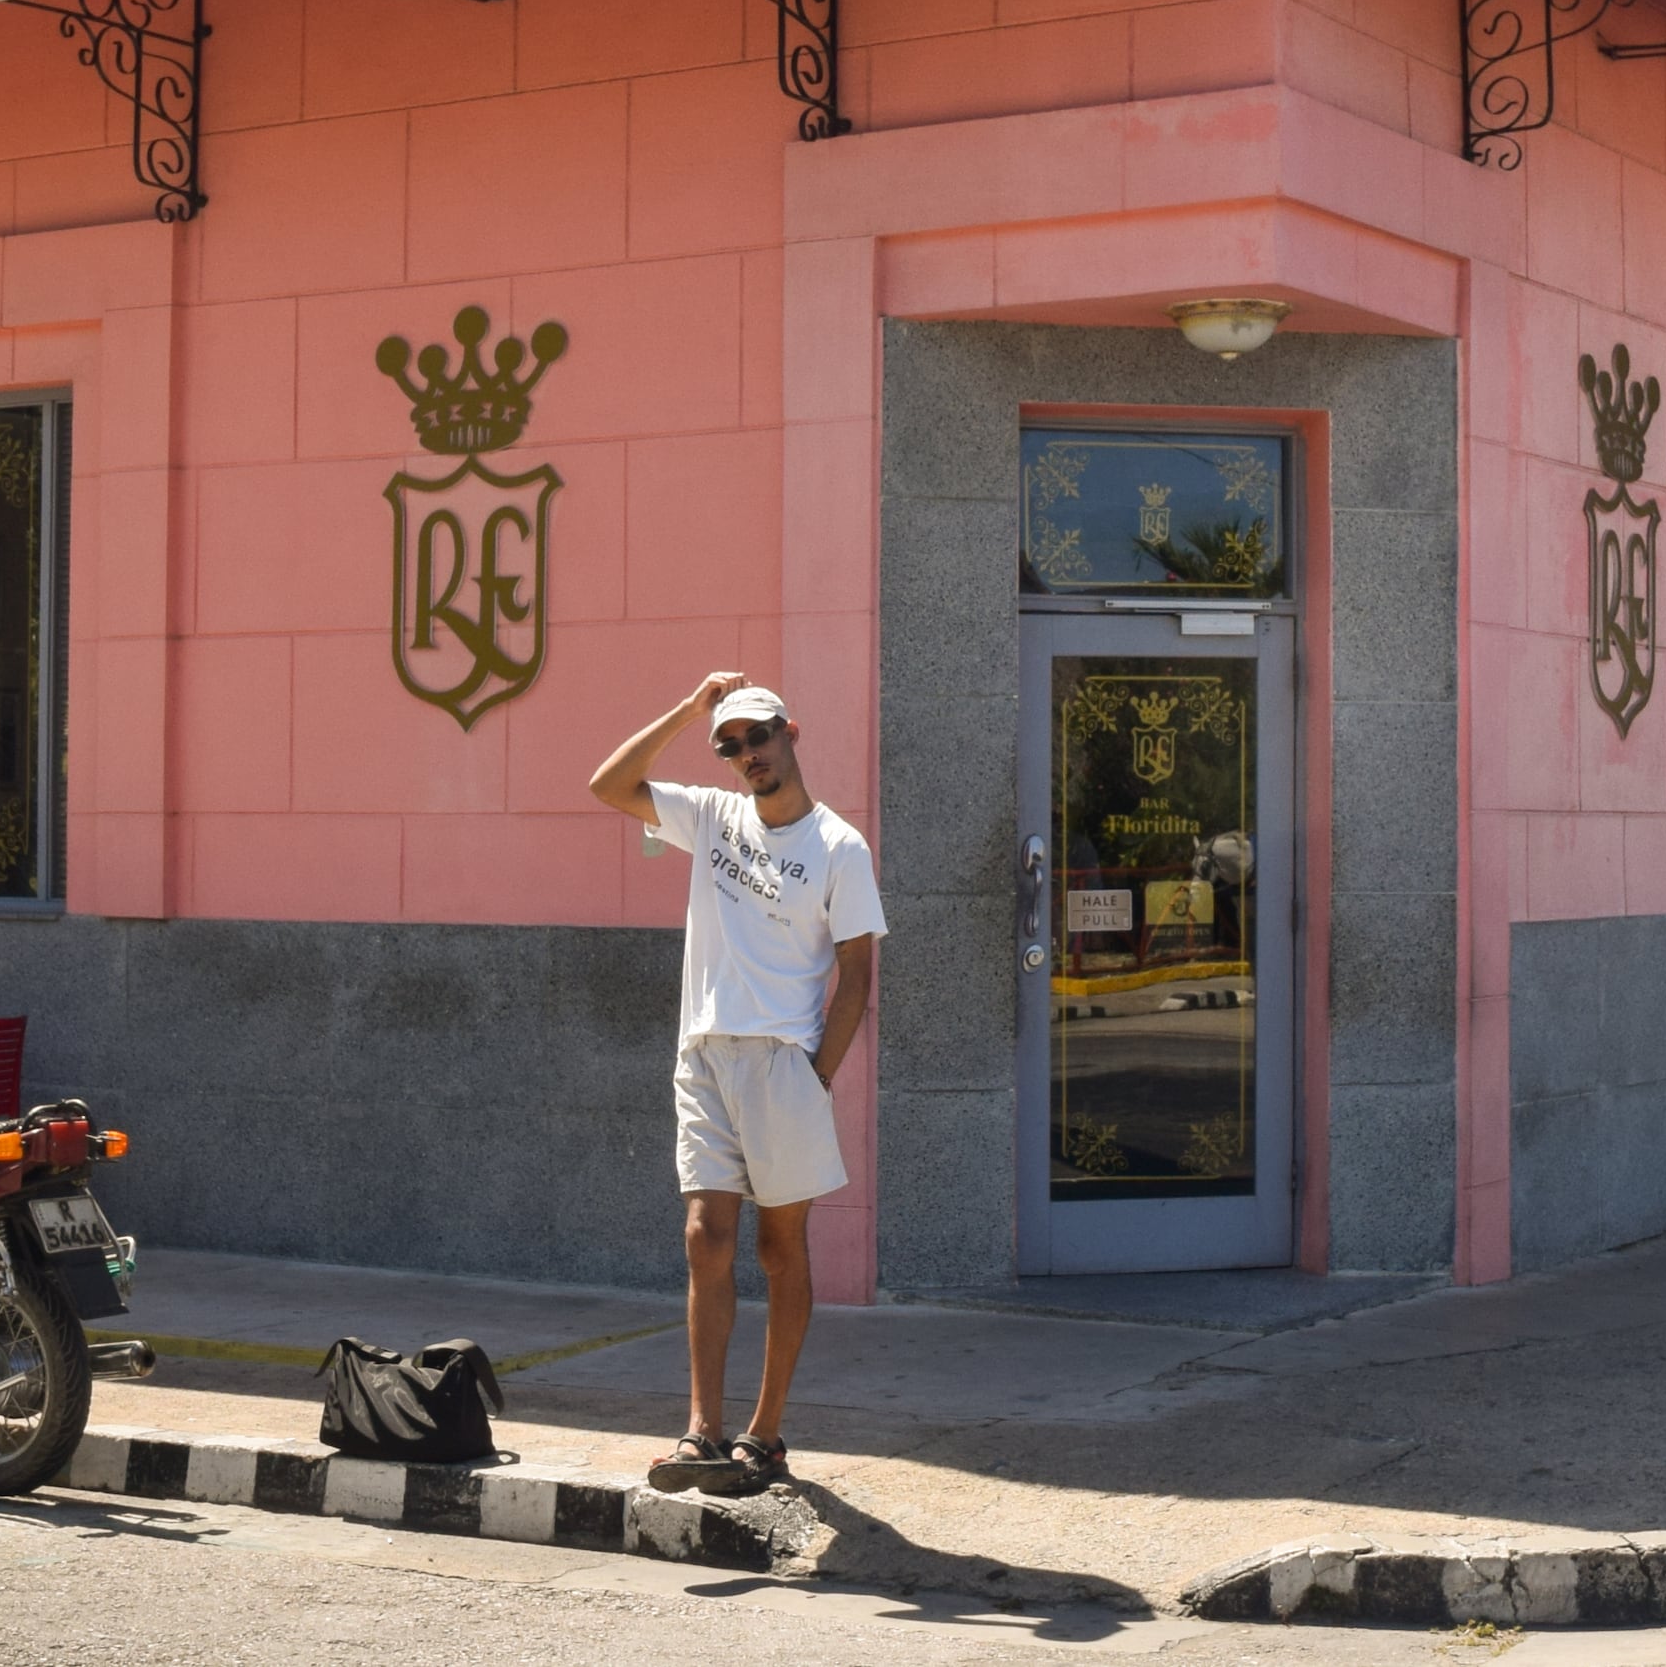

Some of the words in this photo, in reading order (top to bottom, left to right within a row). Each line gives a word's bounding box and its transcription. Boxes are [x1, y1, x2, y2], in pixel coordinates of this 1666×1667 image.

[1140, 797, 1170, 810] BAR
[1106, 814, 1201, 834] Floridita
[722, 826, 771, 867] asere
[776, 858, 808, 885] ya,
[711, 848, 781, 903] gracias.
[1083, 895, 1117, 907] HALE
[1083, 914, 1117, 926] PULL
[59, 1200, 76, 1223] R
[44, 1222, 105, 1248] 54416
